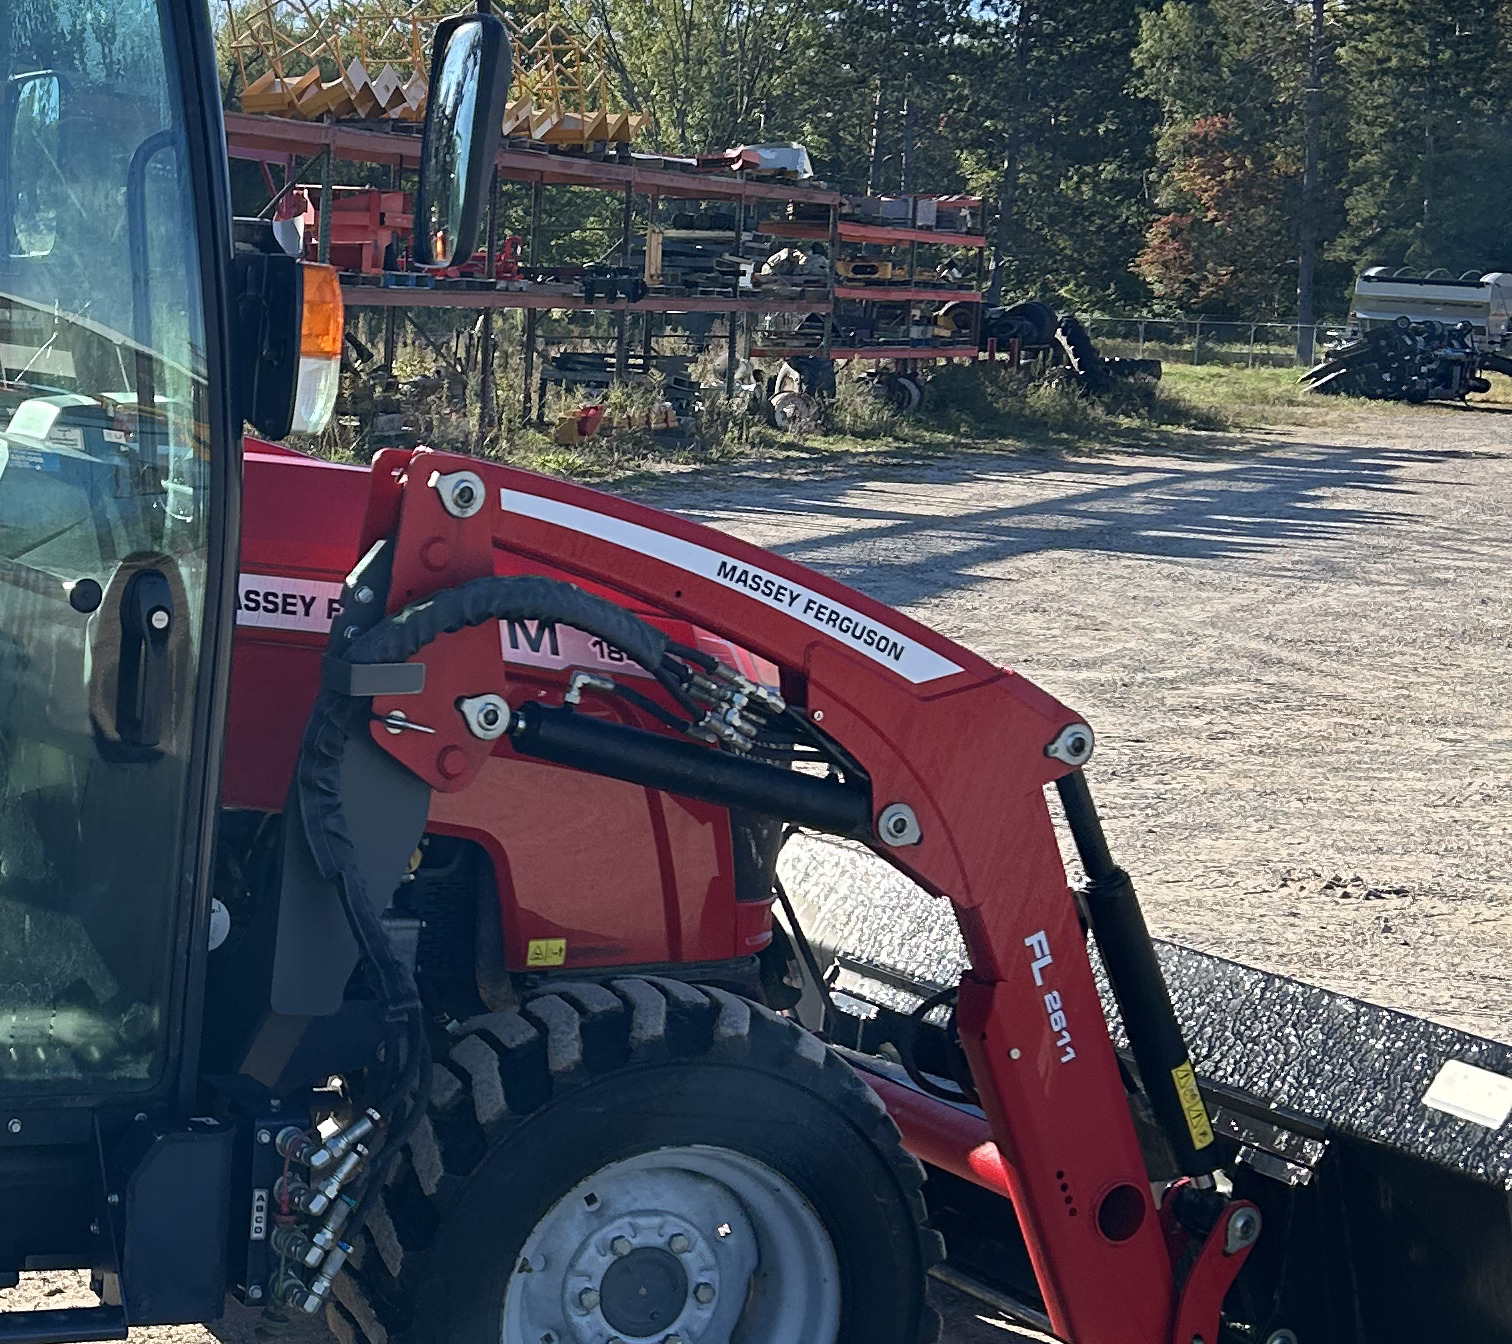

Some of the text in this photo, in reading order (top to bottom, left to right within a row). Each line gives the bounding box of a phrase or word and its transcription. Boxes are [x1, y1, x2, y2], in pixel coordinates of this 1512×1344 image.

[717, 561, 905, 661] MASSEY FERGUSON
[1024, 930, 1076, 1064] FL 2611
